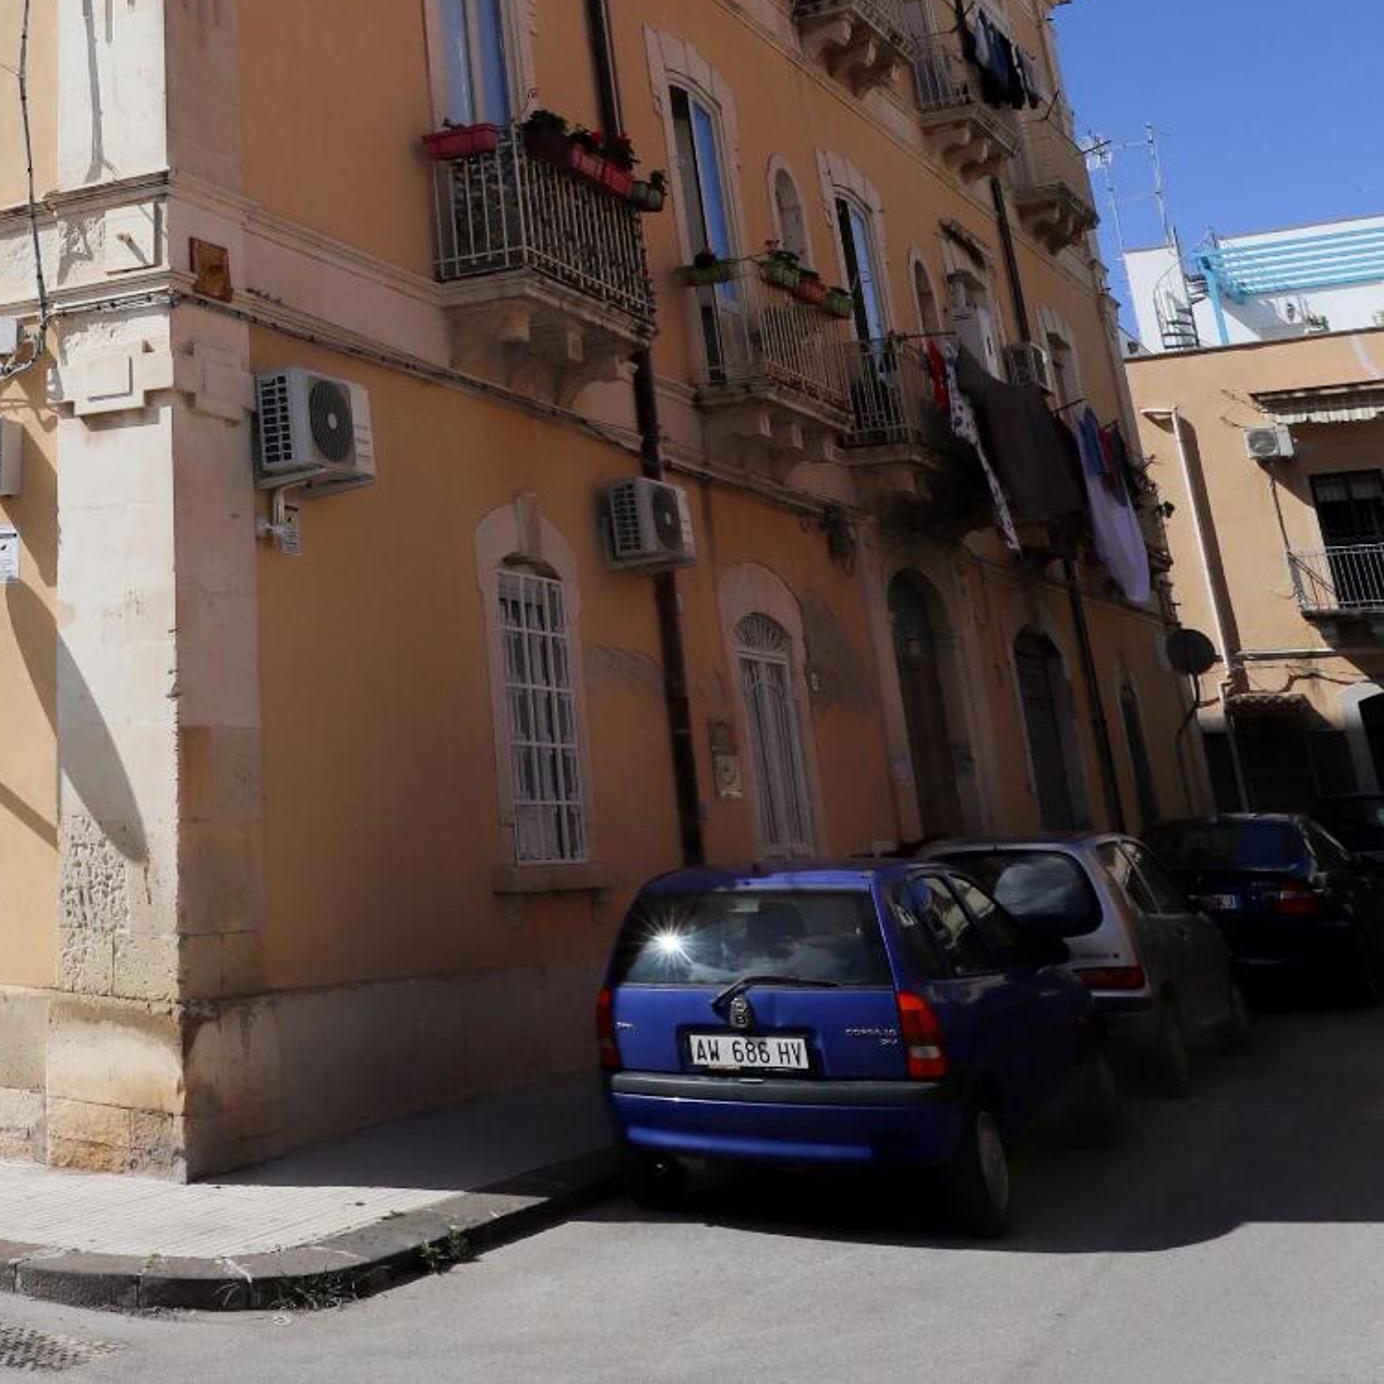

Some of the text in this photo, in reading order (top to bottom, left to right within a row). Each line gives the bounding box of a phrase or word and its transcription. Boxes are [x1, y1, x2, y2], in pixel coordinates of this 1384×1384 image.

[696, 1039, 801, 1066] AW 686 HV
